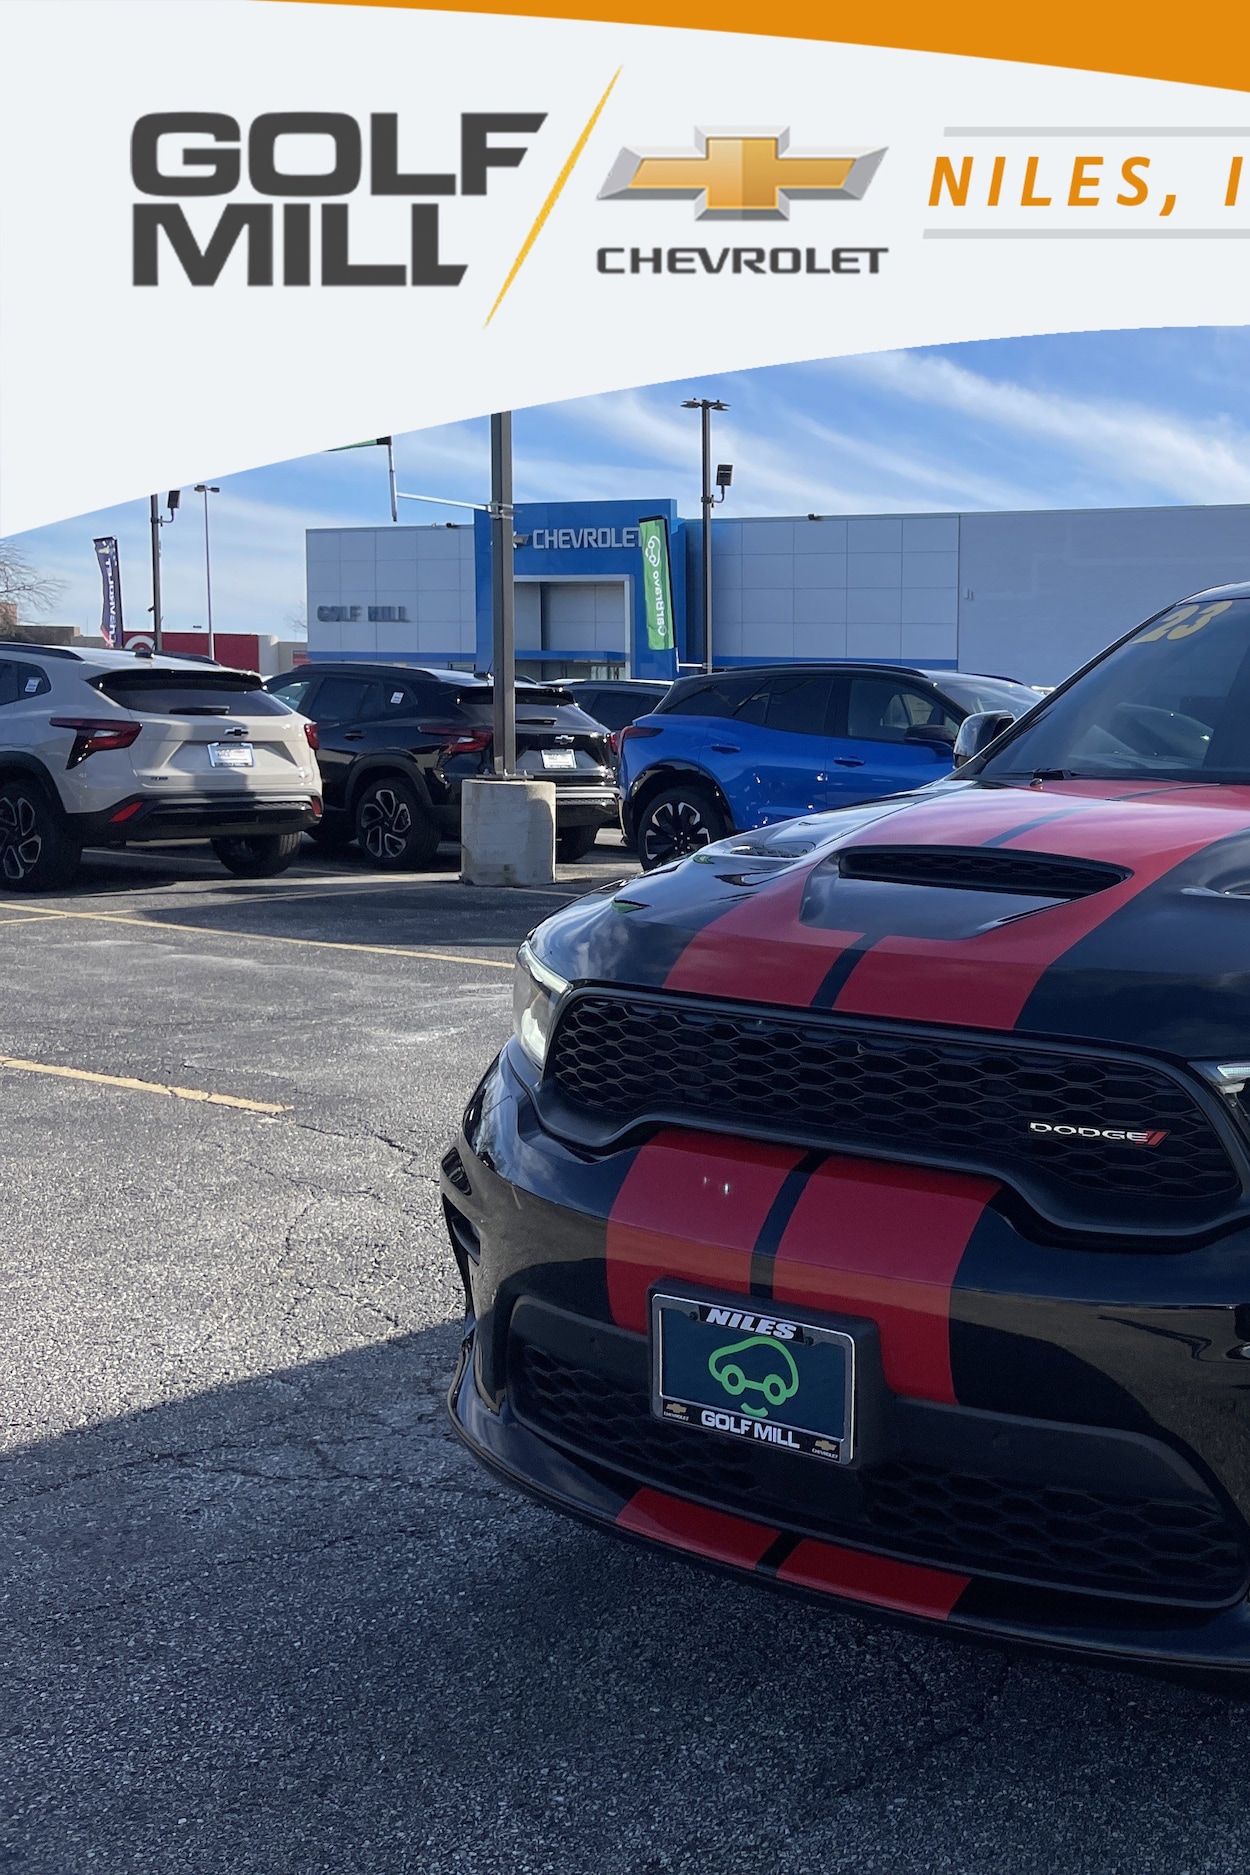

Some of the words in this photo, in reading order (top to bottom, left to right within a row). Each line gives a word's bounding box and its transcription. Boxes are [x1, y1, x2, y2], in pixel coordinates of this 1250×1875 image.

[1130, 600, 1233, 644] 23
[1030, 1122, 1149, 1143] DODGE
[705, 1308, 797, 1340] NILES
[701, 1409, 752, 1435] GOLF
[753, 1422, 800, 1449] MILL
